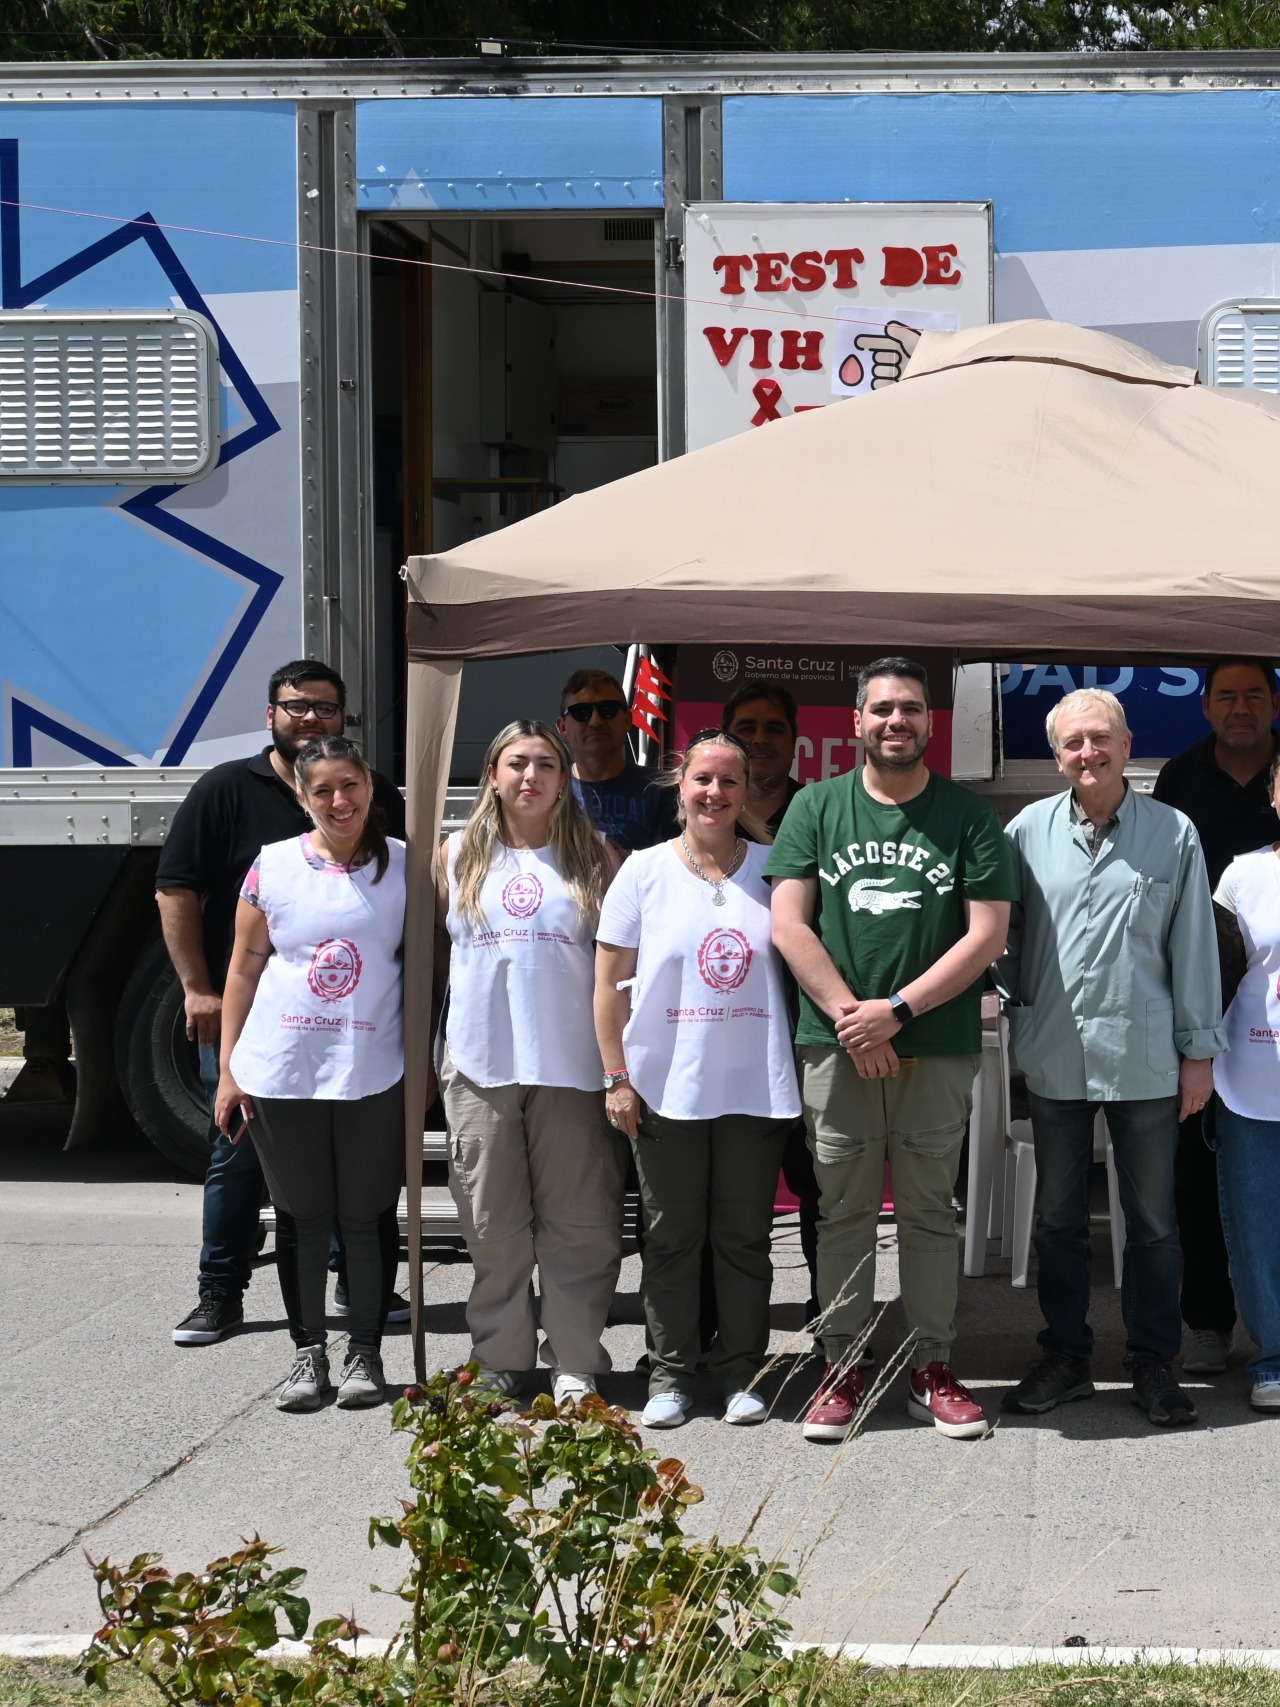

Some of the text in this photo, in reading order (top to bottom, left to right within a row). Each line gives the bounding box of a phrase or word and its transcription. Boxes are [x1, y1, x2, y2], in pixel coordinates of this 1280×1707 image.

[713, 244, 961, 295] TEST DE
[703, 326, 824, 370] VIH
[745, 656, 835, 671] Santa Cruz
[744, 671, 780, 679] Gobierno
[800, 674, 835, 682] provincia
[818, 841, 930, 886] LACOSTE
[472, 928, 529, 943] Santa Cruz
[281, 1013, 342, 1026] Santa Cruz
[666, 1006, 725, 1018] Santa Cruz
[1249, 1027, 1280, 1038] Santa
